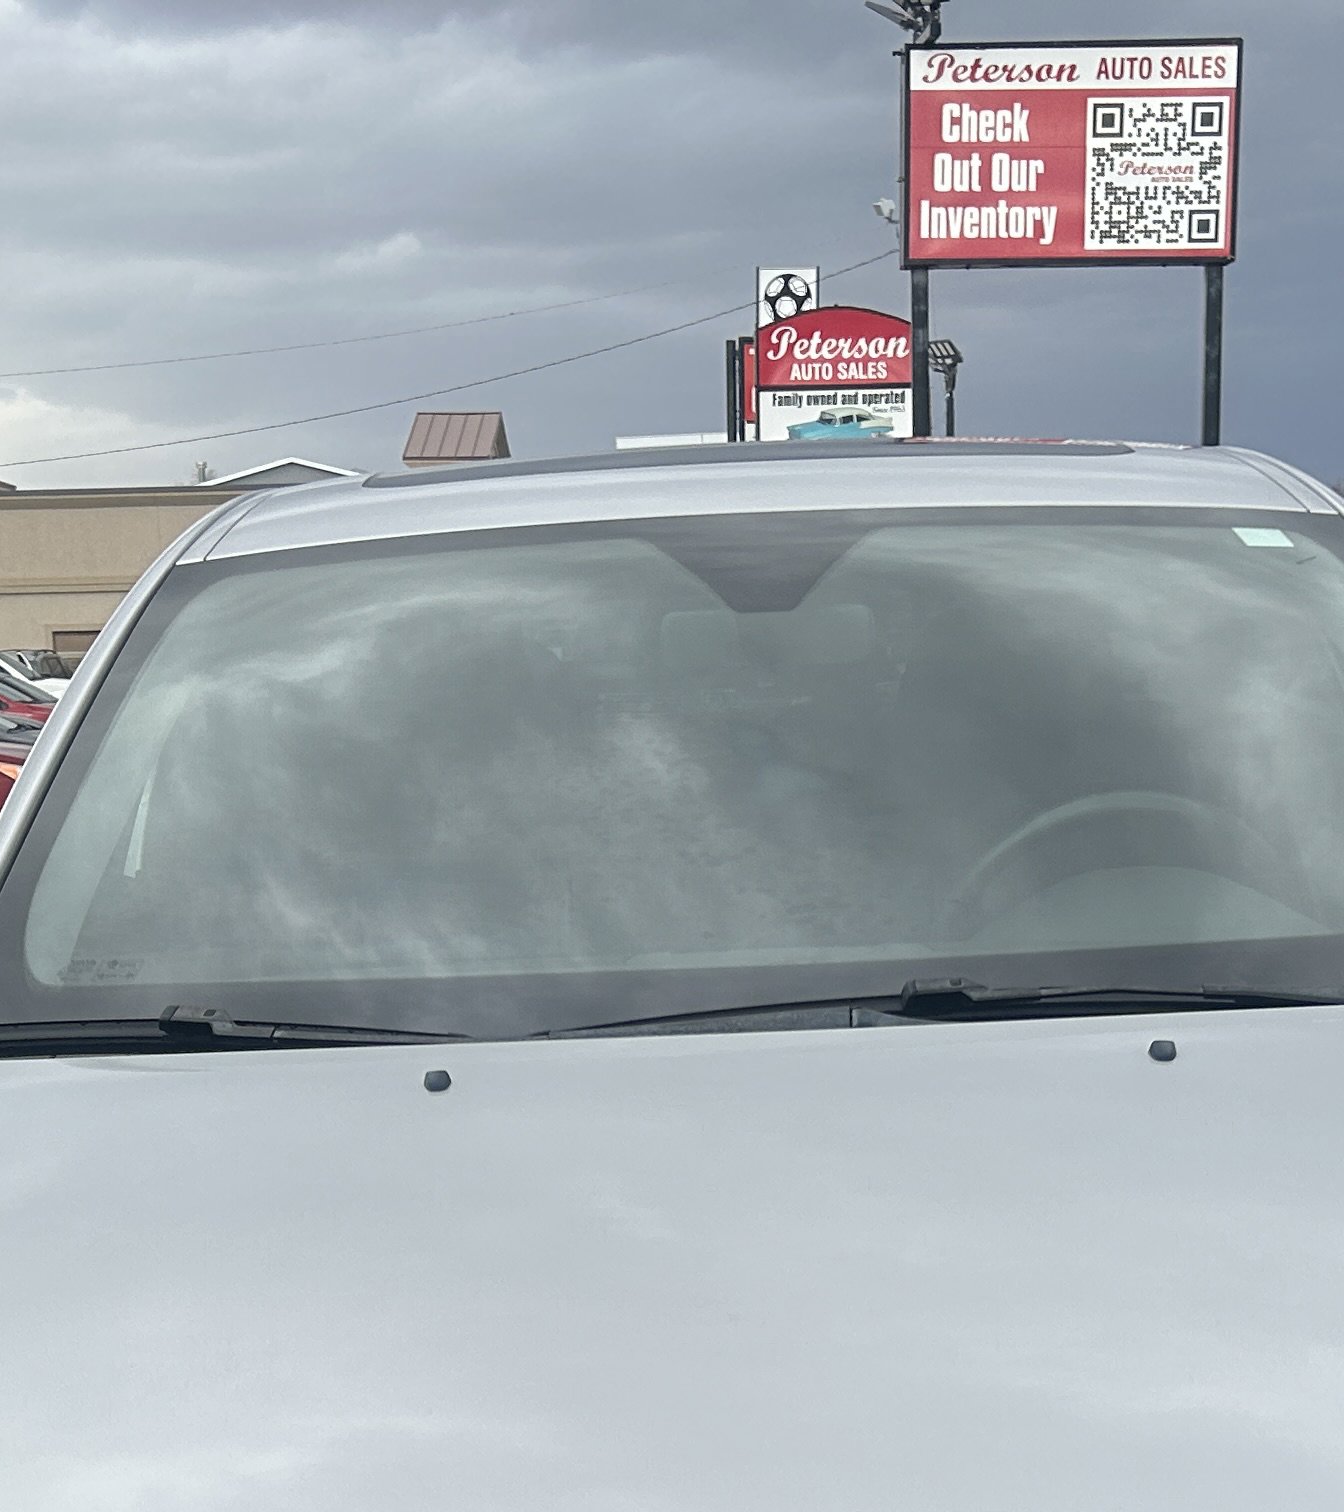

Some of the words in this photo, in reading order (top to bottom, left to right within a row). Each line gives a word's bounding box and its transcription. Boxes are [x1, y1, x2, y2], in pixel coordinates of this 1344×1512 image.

[922, 53, 1080, 83] Peterson
[1096, 57, 1152, 80] AUTO
[1160, 56, 1227, 80] SALES
[941, 102, 1030, 143] Check
[933, 152, 982, 192] Out
[991, 152, 1045, 192] Our
[1117, 160, 1194, 176] Peterson
[919, 199, 1058, 245] Inventory
[766, 326, 910, 361] Peterson
[789, 363, 833, 381] AUTO
[837, 361, 888, 380] SALES
[772, 393, 803, 408] Family
[806, 392, 838, 406] owned
[841, 392, 859, 405] and
[862, 391, 906, 407] operated
